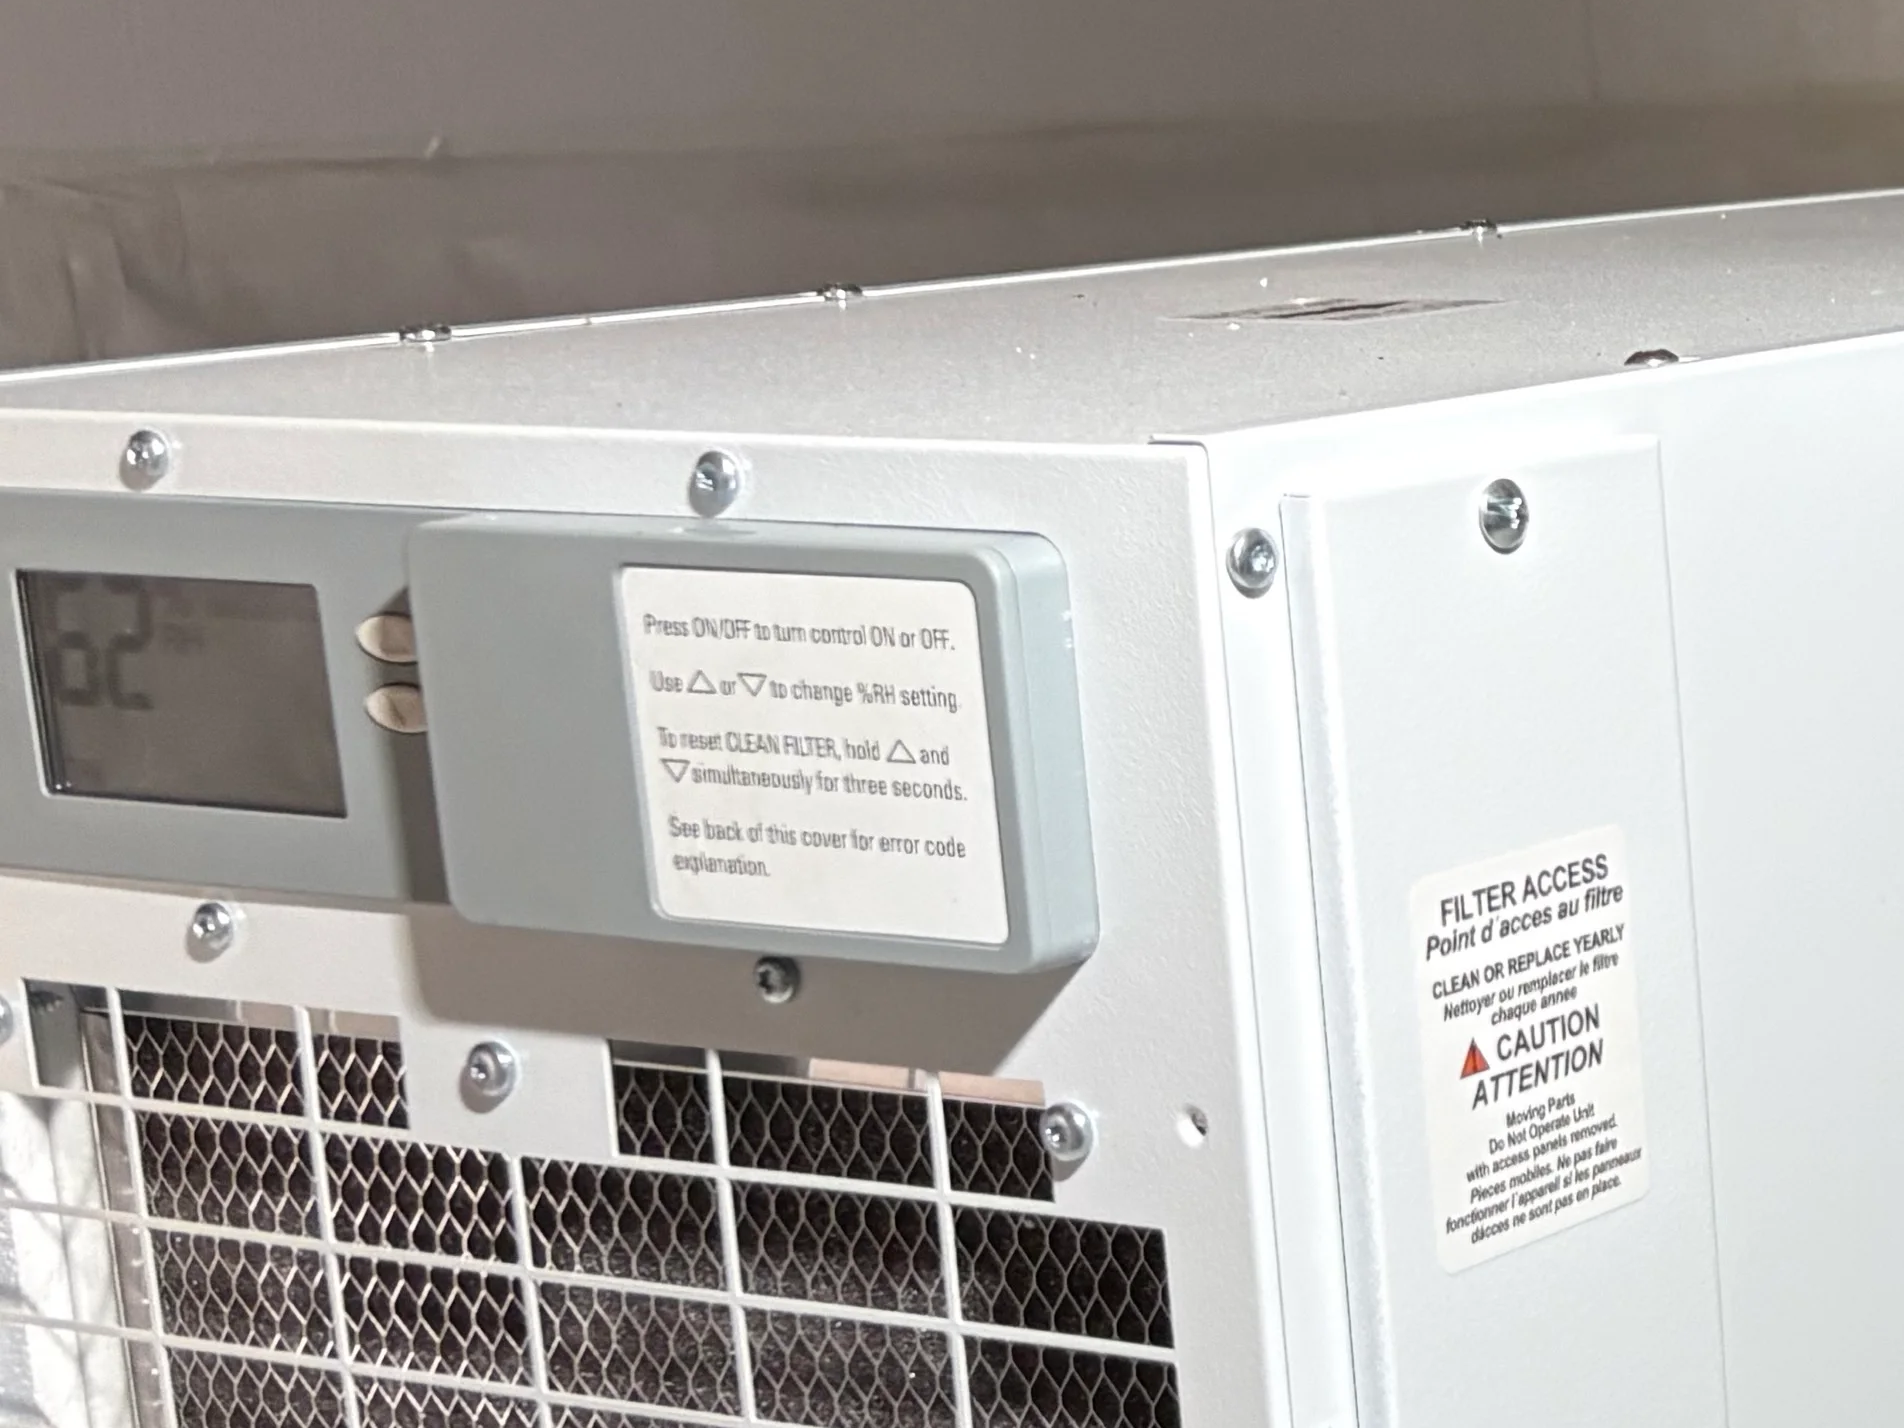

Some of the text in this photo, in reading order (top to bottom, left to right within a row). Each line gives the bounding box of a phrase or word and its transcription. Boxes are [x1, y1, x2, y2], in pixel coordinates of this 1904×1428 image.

[643, 613, 955, 651] Press ON/OFF to turn control ON or OFF.
[650, 671, 683, 693] Use
[719, 680, 737, 696] or
[769, 680, 788, 700] to
[790, 680, 853, 707] change
[656, 726, 678, 749] To
[680, 733, 723, 751] reset
[725, 731, 780, 754] CLEAN
[844, 738, 881, 761] hold
[919, 746, 950, 766] and
[692, 765, 967, 801] simultaneously for three seconds.
[668, 815, 966, 859] See back of this cover for error code
[1441, 854, 1608, 926] FILTER ACCESS
[1426, 926, 1476, 961] Point
[1557, 898, 1580, 920] au
[1584, 885, 1623, 912] filtre
[1432, 924, 1624, 999] CLEAN OR REPLACE YEARLY
[1443, 953, 1619, 1021] Nettoyer ou remplacer le filtre
[1491, 999, 1537, 1026] chaque
[1497, 1004, 1600, 1061] CAUTION
[1473, 1040, 1603, 1109] ATTENTION
[1488, 1103, 1595, 1155] Do Not Operate Unit
[1506, 1093, 1576, 1128] Moving Parts
[1466, 1163, 1490, 1183] with
[1492, 1149, 1531, 1173] access
[1532, 1134, 1568, 1161] panels
[1556, 1154, 1572, 1171] Ne
[1573, 1147, 1593, 1169] pas
[1595, 1138, 1618, 1156] faire
[1562, 1171, 1573, 1189] si
[1574, 1167, 1590, 1184] les
[1512, 1212, 1527, 1228] ne
[1528, 1199, 1553, 1221] sont
[1554, 1193, 1574, 1215] pas
[1576, 1187, 1590, 1202] en
